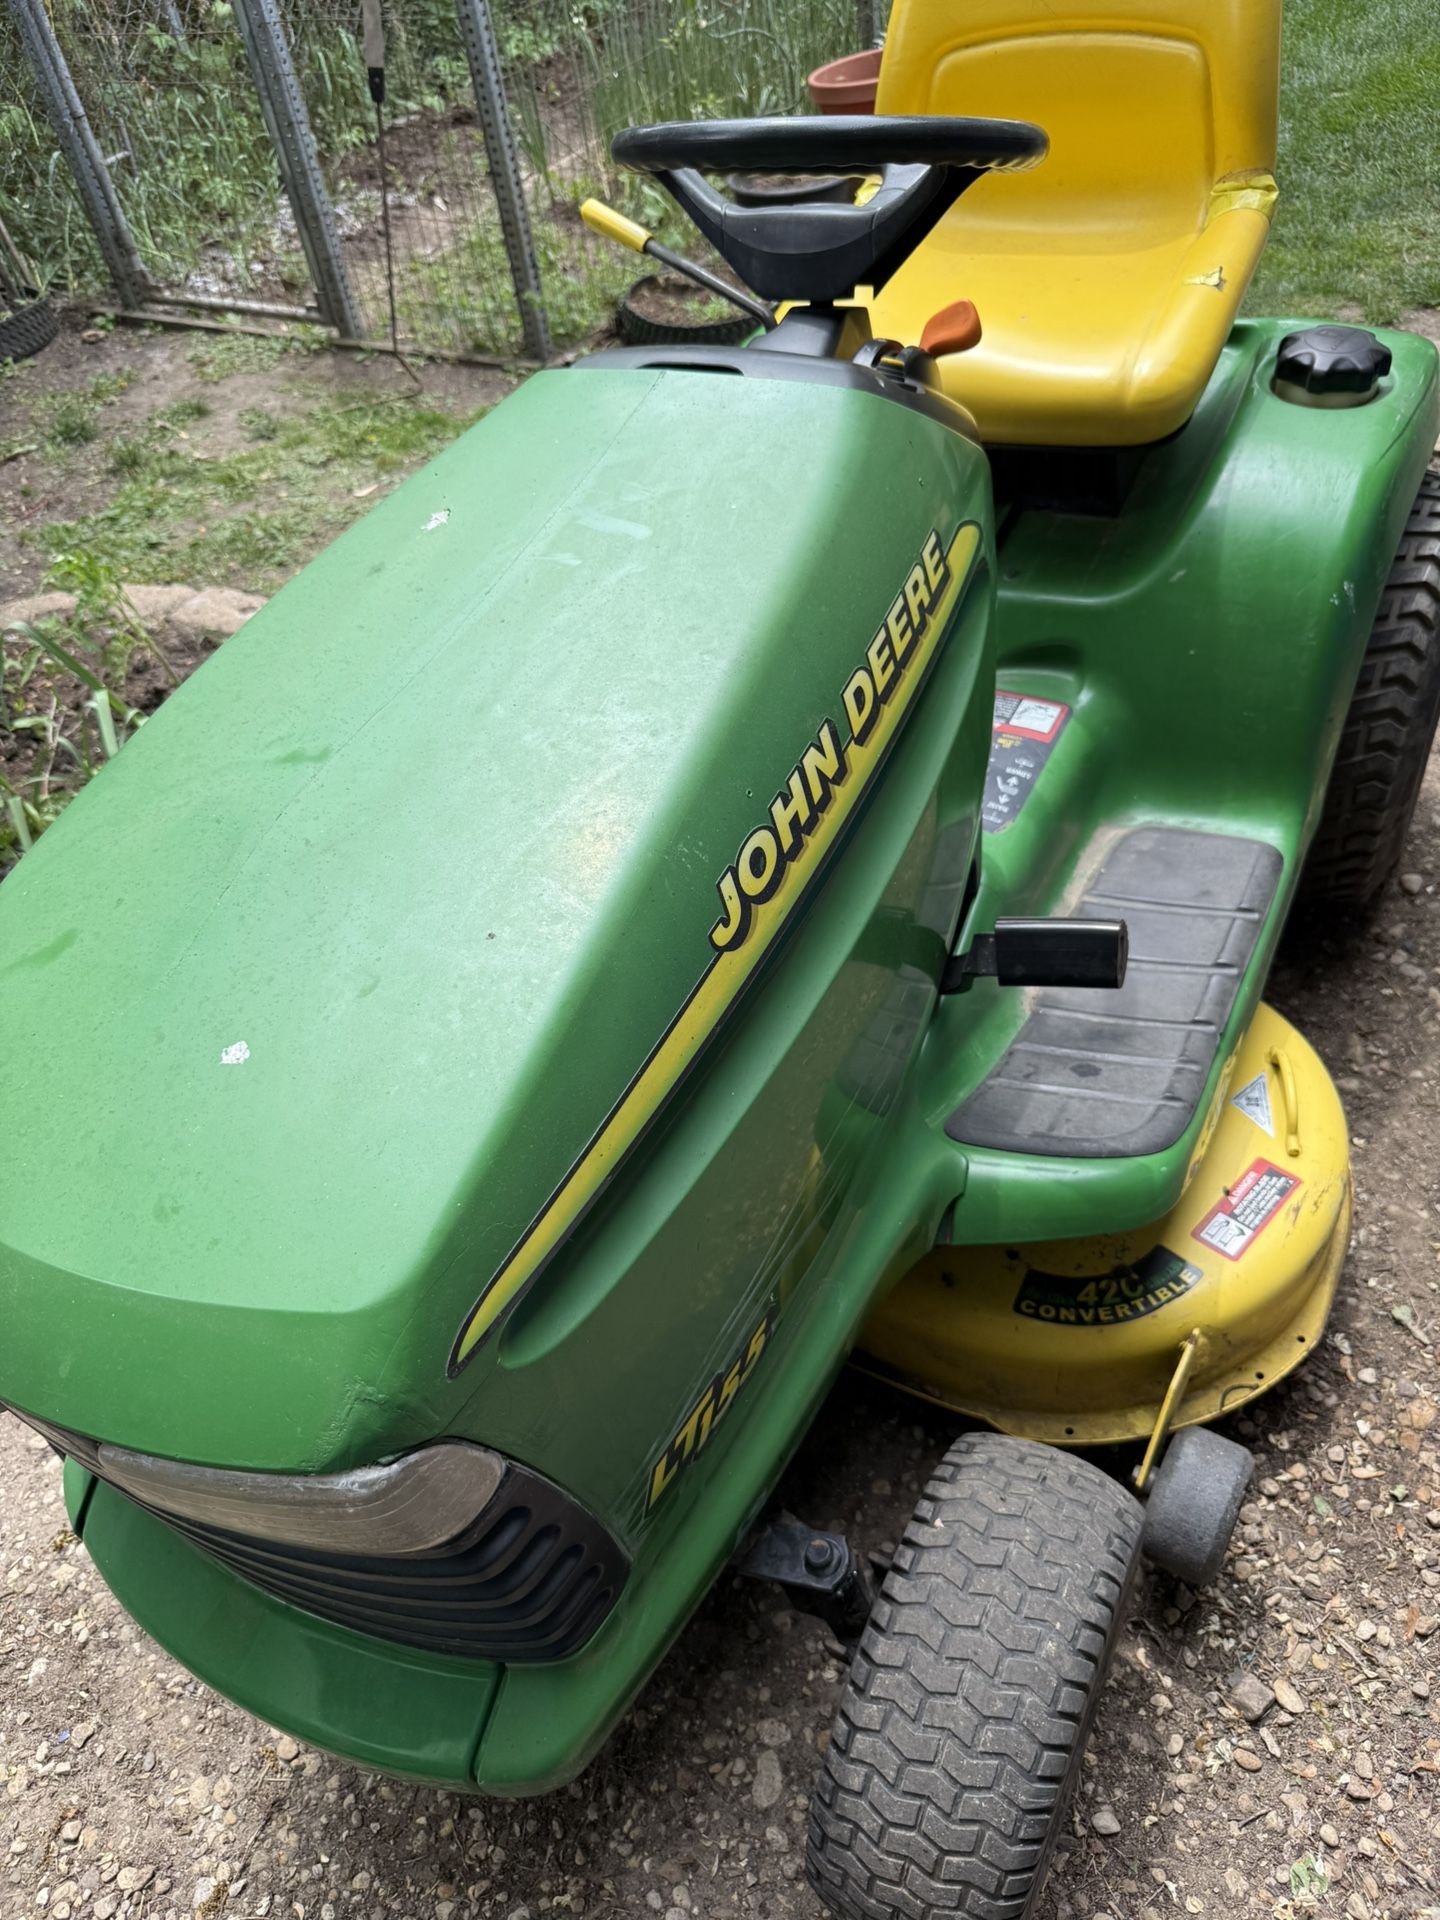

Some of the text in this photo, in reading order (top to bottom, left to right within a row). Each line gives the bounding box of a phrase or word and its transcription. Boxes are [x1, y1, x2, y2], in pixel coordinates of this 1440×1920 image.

[708, 528, 950, 950] JOHN DEERE
[1019, 1267, 1197, 1324] CONVERTIBLE
[648, 1316, 768, 1511] LT155
